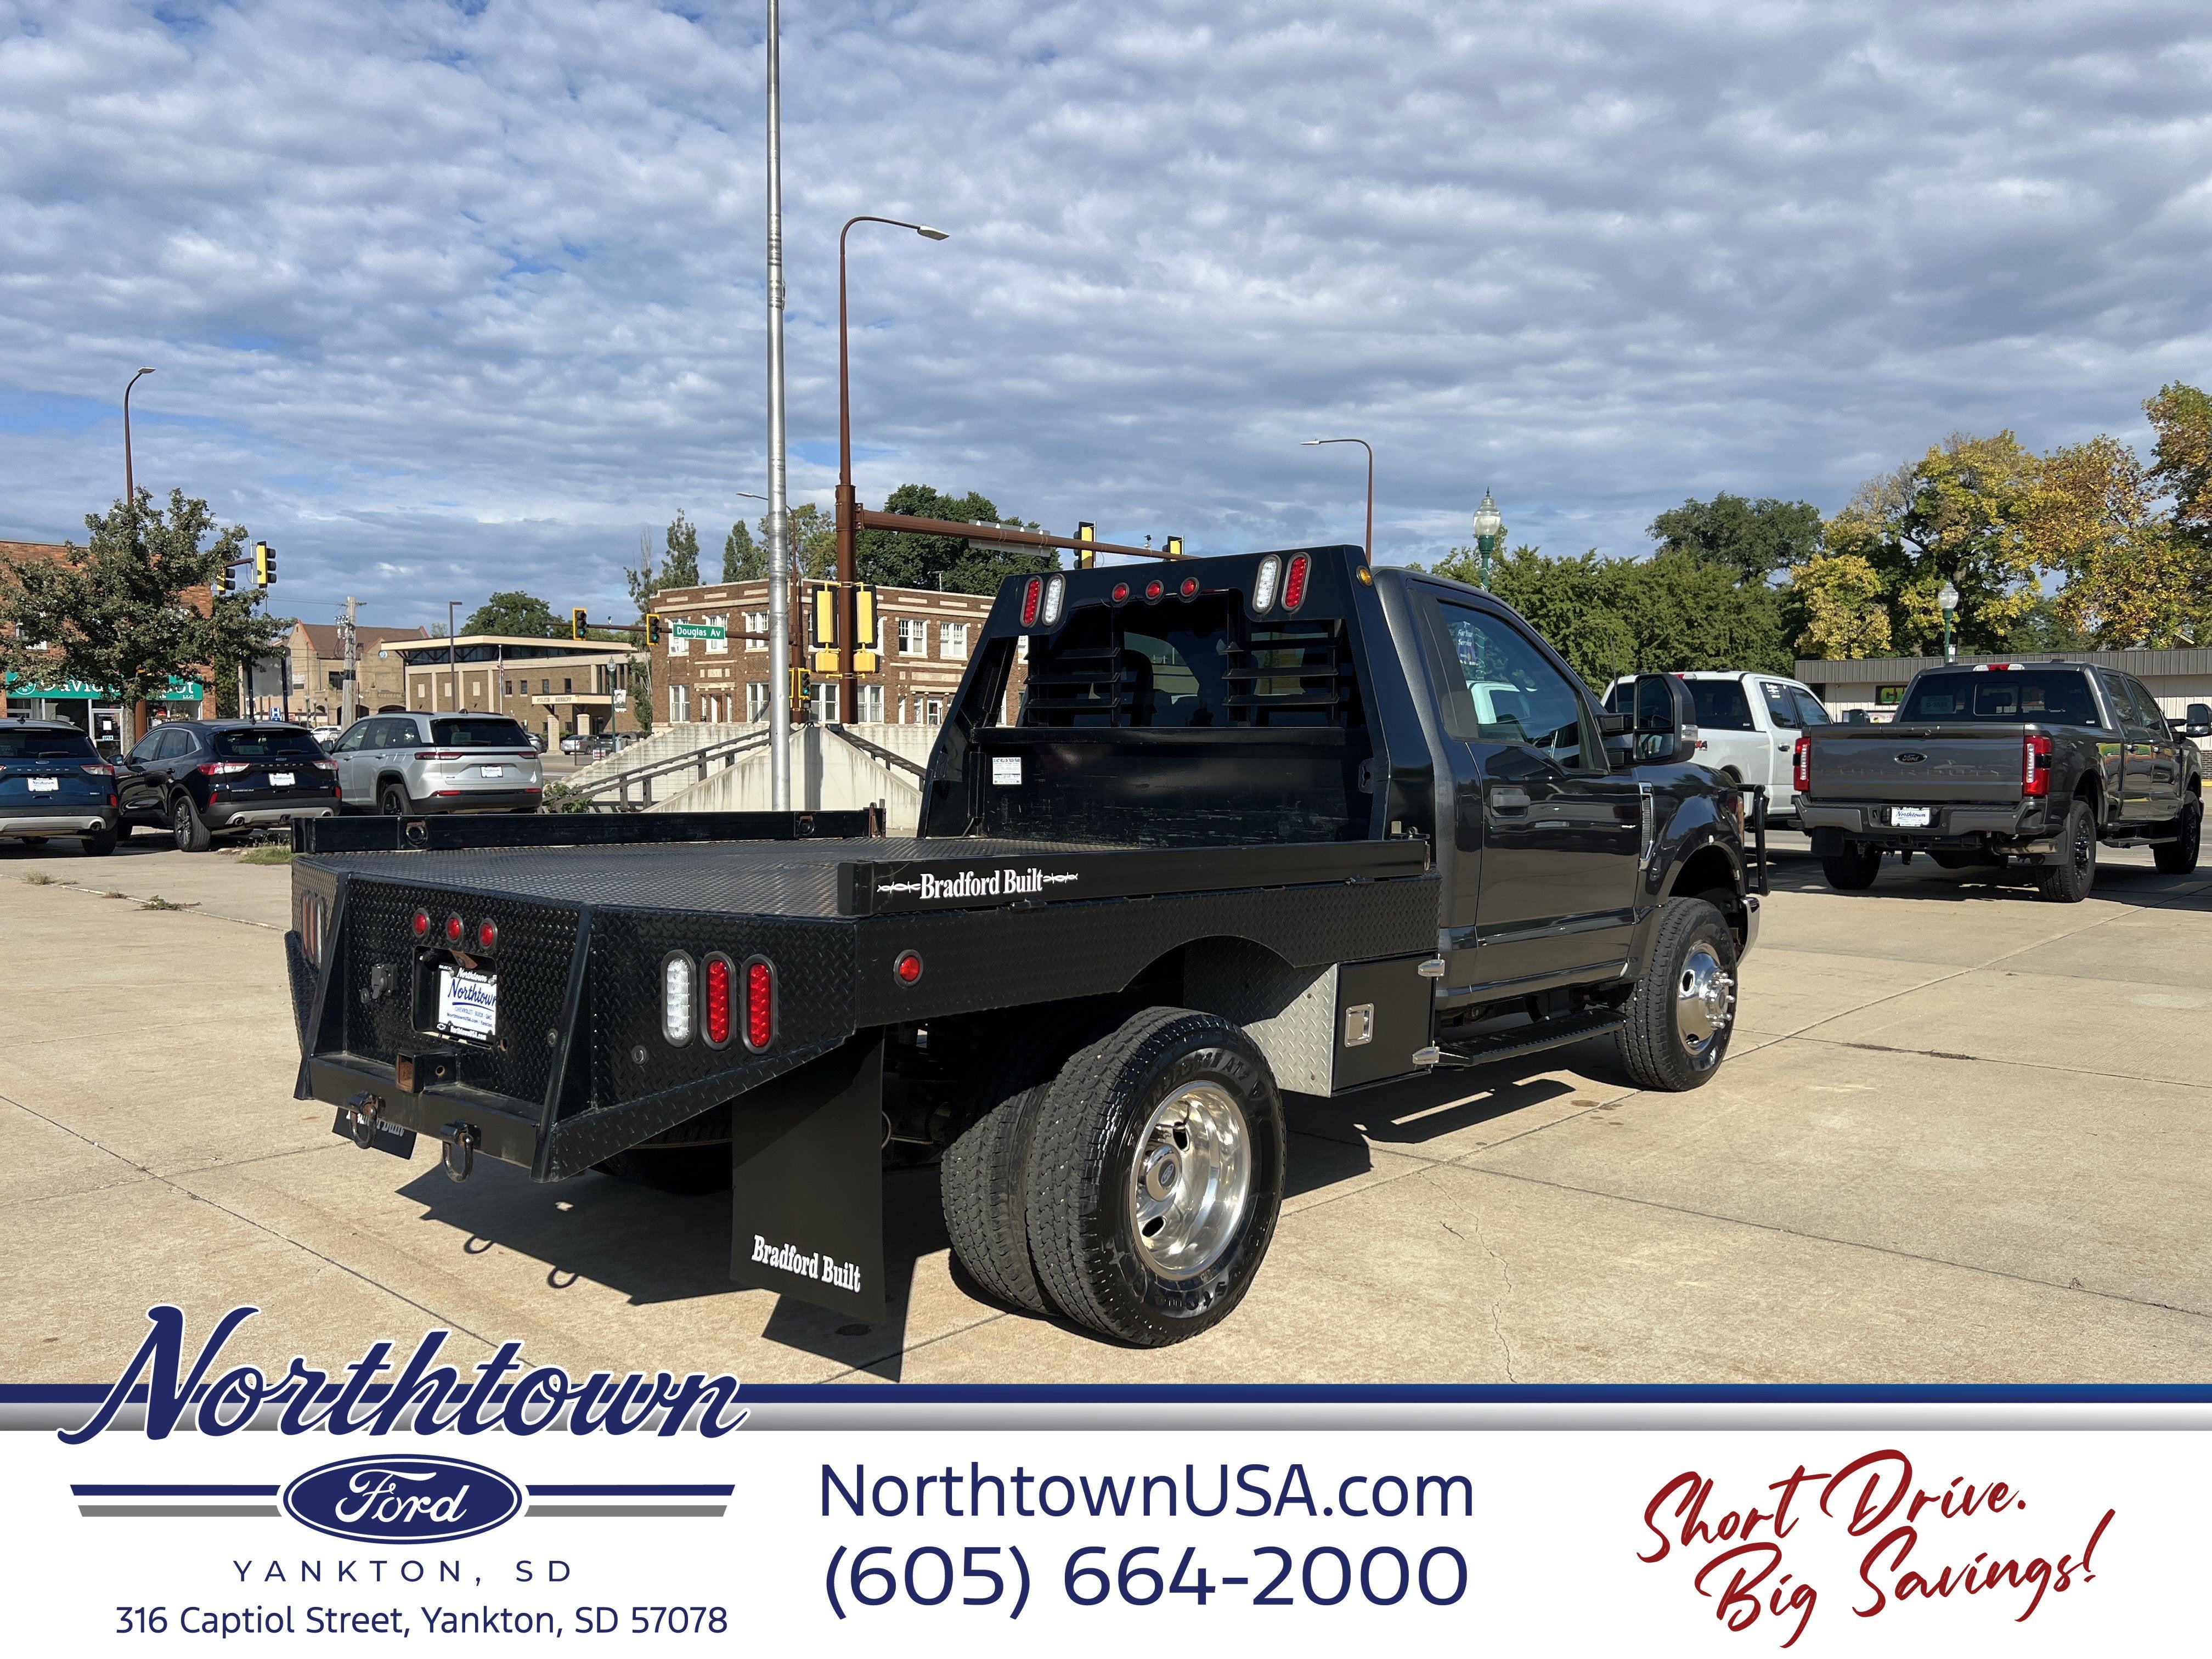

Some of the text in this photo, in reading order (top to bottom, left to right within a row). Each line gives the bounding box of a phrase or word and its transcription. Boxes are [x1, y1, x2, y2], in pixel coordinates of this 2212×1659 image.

[676, 626, 721, 638] Douglas Av
[272, 707, 280, 717] H
[919, 868, 1043, 899] Bradford Built
[456, 967, 488, 982] Northtown
[751, 1234, 861, 1293] Bradford Built
